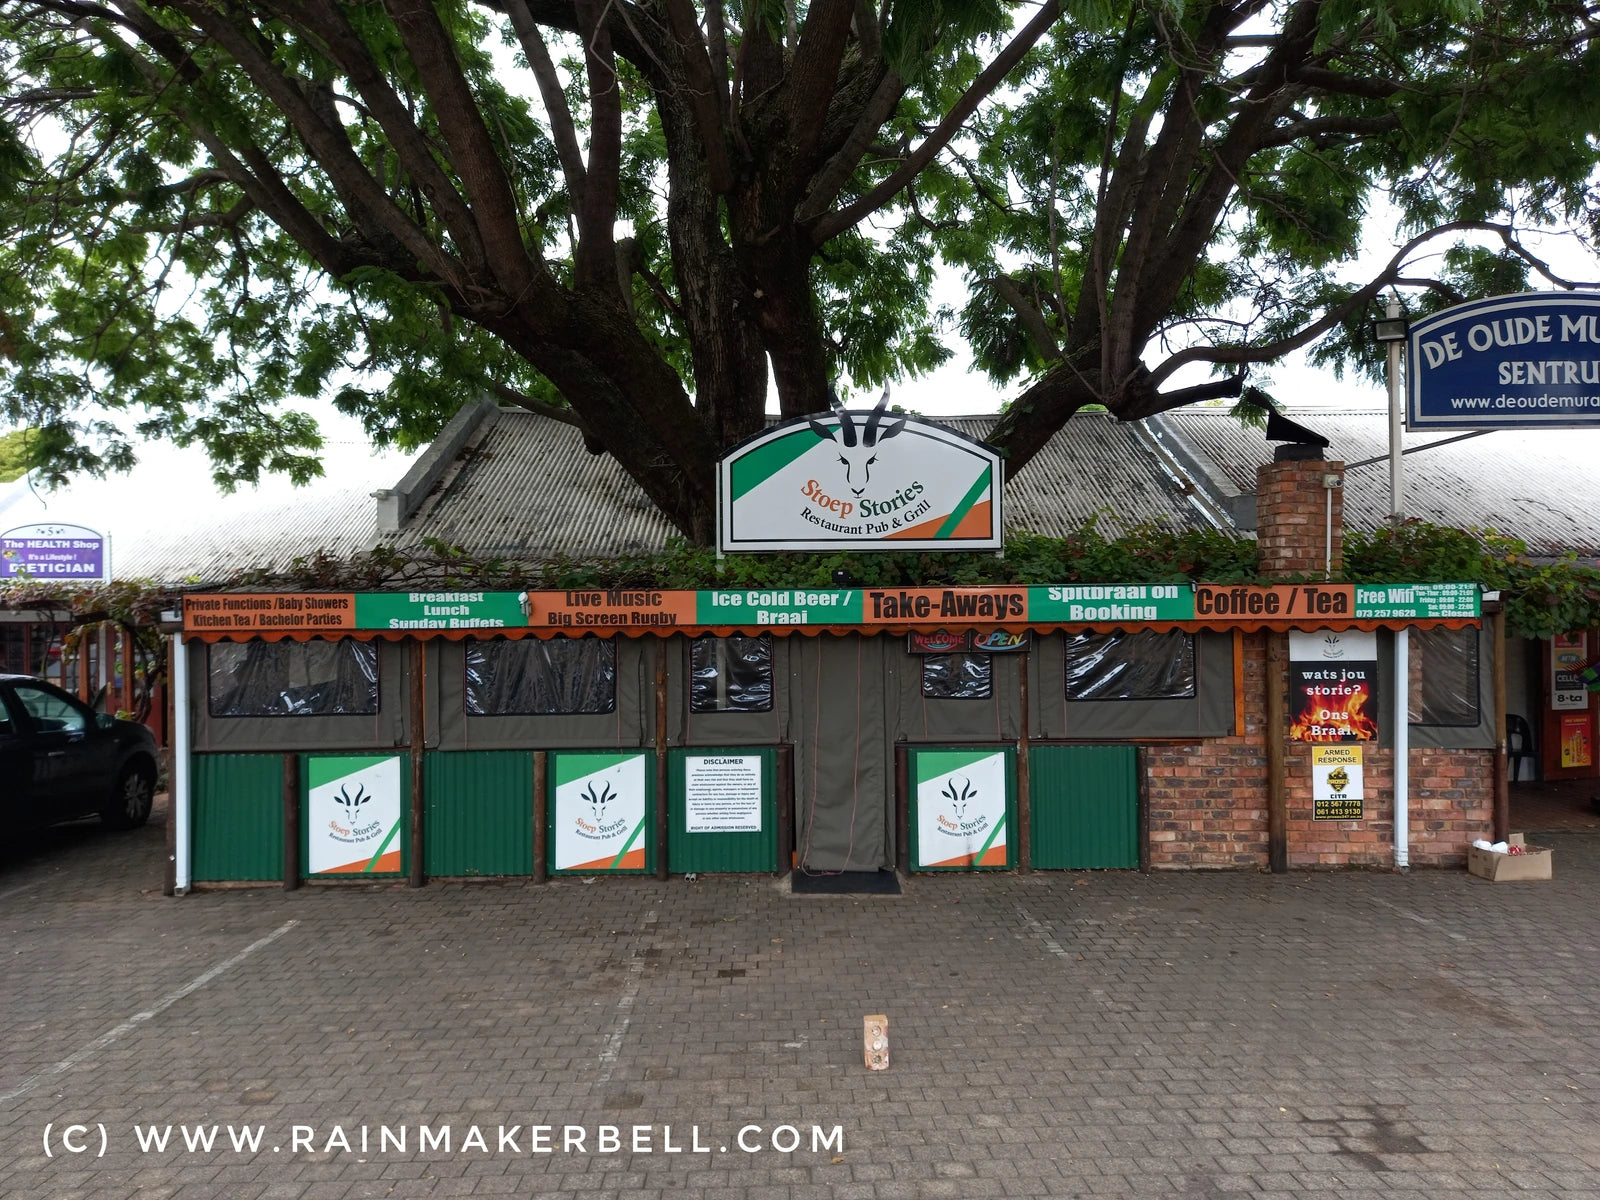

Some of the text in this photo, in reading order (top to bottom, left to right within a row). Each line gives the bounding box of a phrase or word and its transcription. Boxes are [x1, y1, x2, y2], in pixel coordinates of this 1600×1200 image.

[1421, 332, 1463, 370] DE
[1467, 316, 1552, 351] OUDE
[800, 479, 924, 519] Stoep Stories
[800, 500, 932, 535] Restaurant Pub & Grill
[4, 540, 100, 550] The HEALTH Shop
[409, 592, 484, 602] Breakfast
[566, 590, 663, 606] Live Music
[712, 591, 742, 606] Ice
[747, 591, 789, 606] Cold
[794, 591, 839, 606] Beer
[1048, 585, 1178, 602] Spitbraai on
[1357, 588, 1414, 603] Free Wifi
[186, 599, 221, 611] Private
[223, 598, 272, 611] Functions
[305, 597, 349, 609] Showers
[870, 591, 1023, 620] Take-Aways
[1197, 588, 1347, 614] Coffee / Tea
[424, 605, 470, 615] Lunch
[757, 610, 807, 624] Braai
[1070, 604, 1157, 621] Booking
[1356, 609, 1416, 617] 073 257 9628
[193, 614, 231, 626] Kitchen
[233, 614, 250, 626] Tea
[259, 613, 304, 625] Bachelor
[307, 613, 342, 625] Parties
[389, 618, 504, 628] Sunday Buffets
[548, 612, 677, 626] Big Screen Rugby
[914, 633, 965, 644] WELCOME
[974, 632, 1023, 646] OPEN
[1302, 669, 1366, 682] wats jou
[1306, 684, 1361, 695] storie?
[1320, 709, 1349, 720] Ons
[1311, 725, 1356, 736] Braai.
[329, 820, 380, 836] Stoep Stories
[575, 817, 626, 833] Stoep Stories
[937, 814, 986, 830] Stoep Stories
